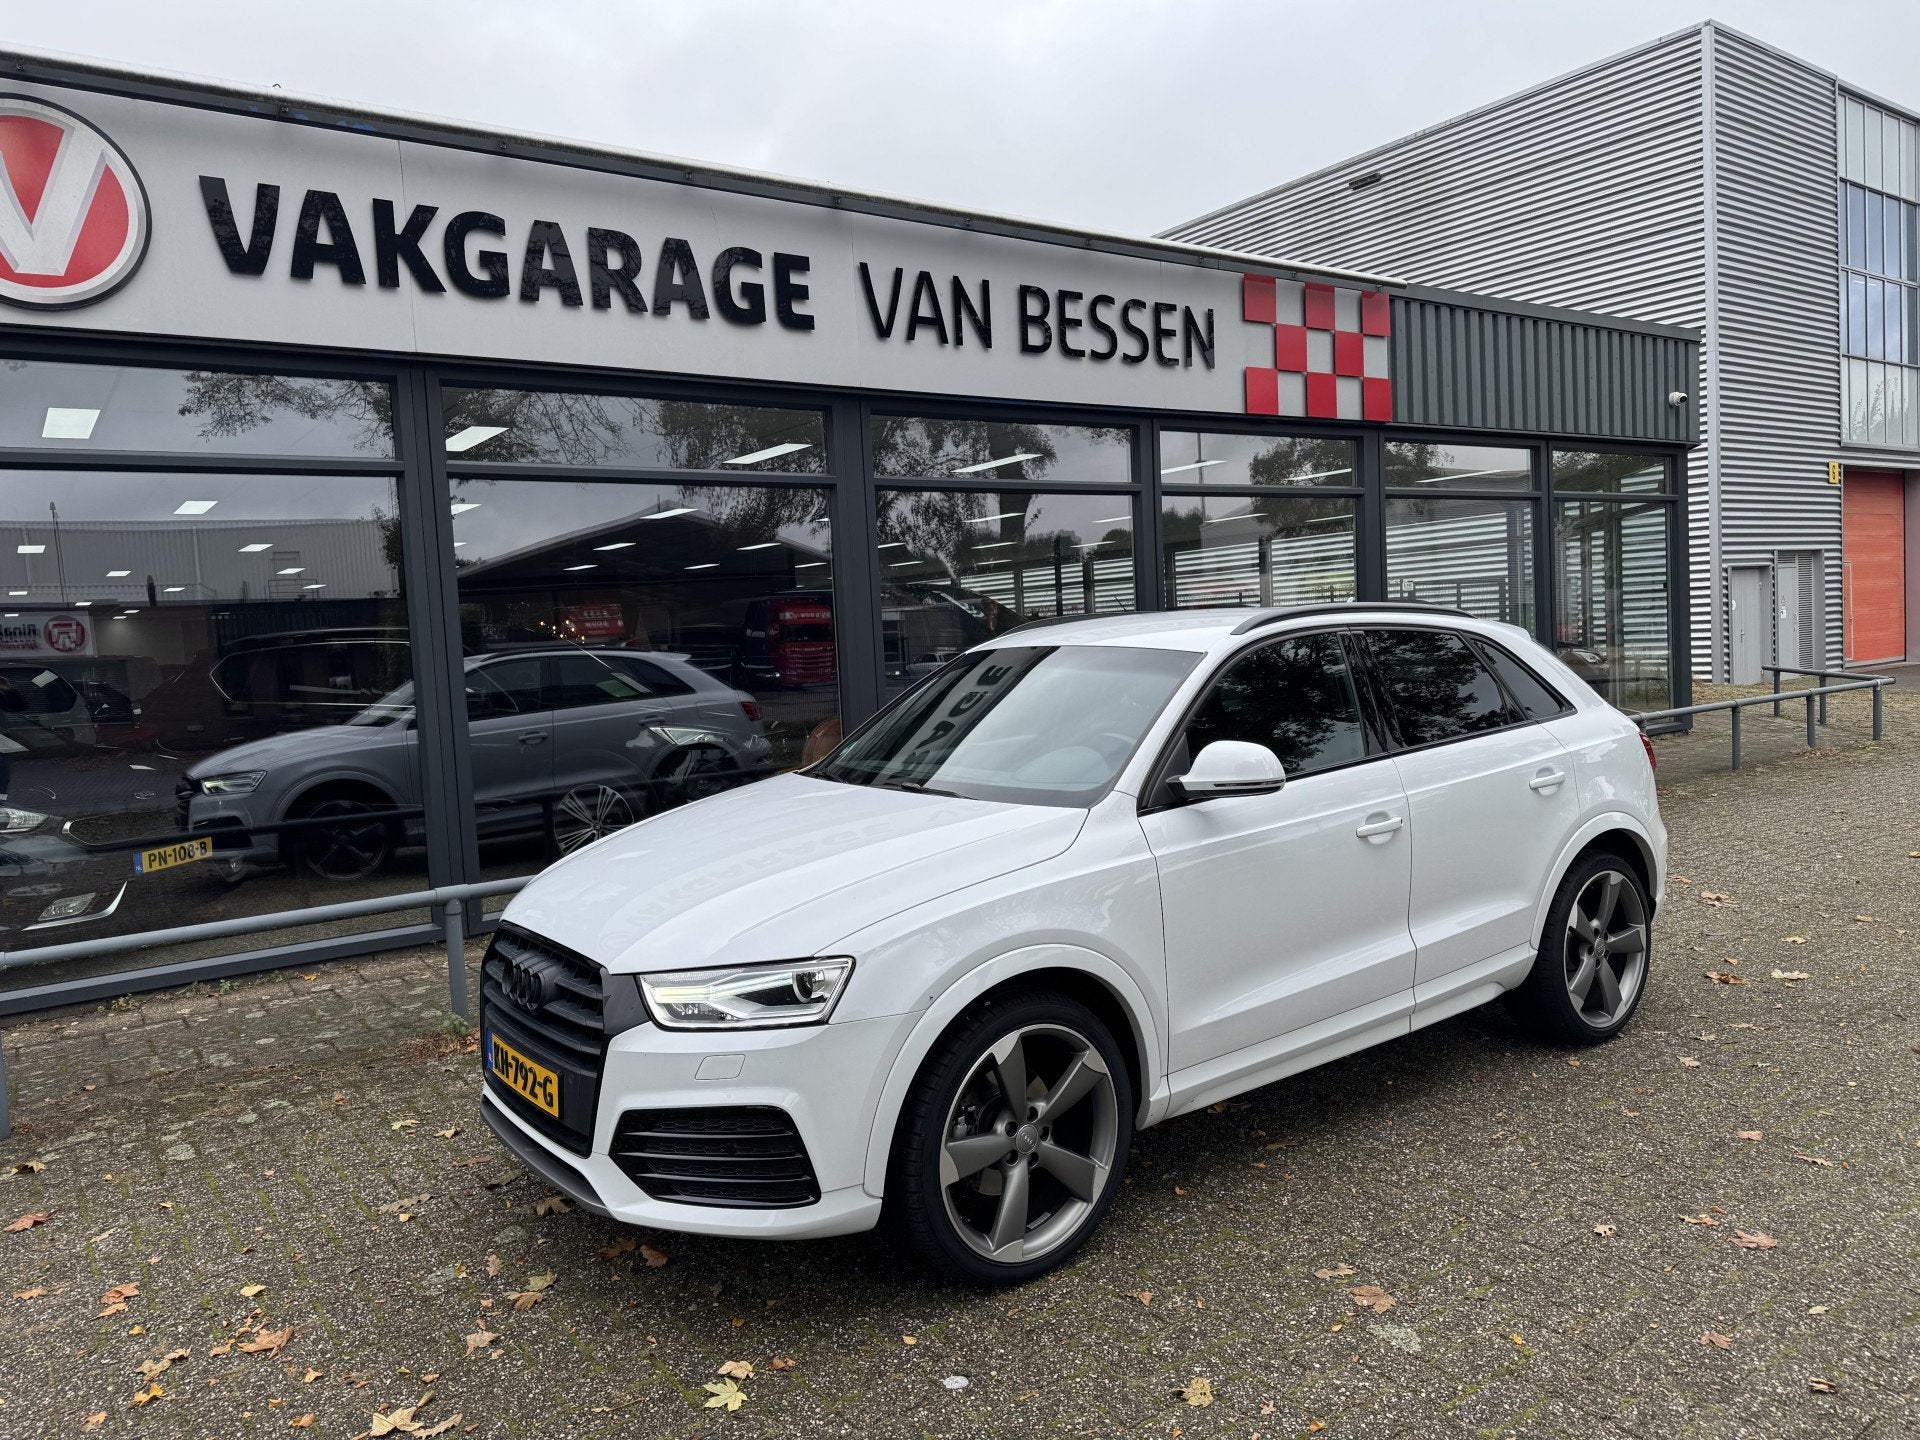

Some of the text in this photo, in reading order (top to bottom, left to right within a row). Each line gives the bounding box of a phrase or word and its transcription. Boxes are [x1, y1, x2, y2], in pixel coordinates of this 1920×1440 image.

[199, 174, 1215, 369] VAKGARAGE VAN BESSEN
[148, 841, 208, 868] PN-108-B
[494, 1041, 553, 1108] KH-792-G
